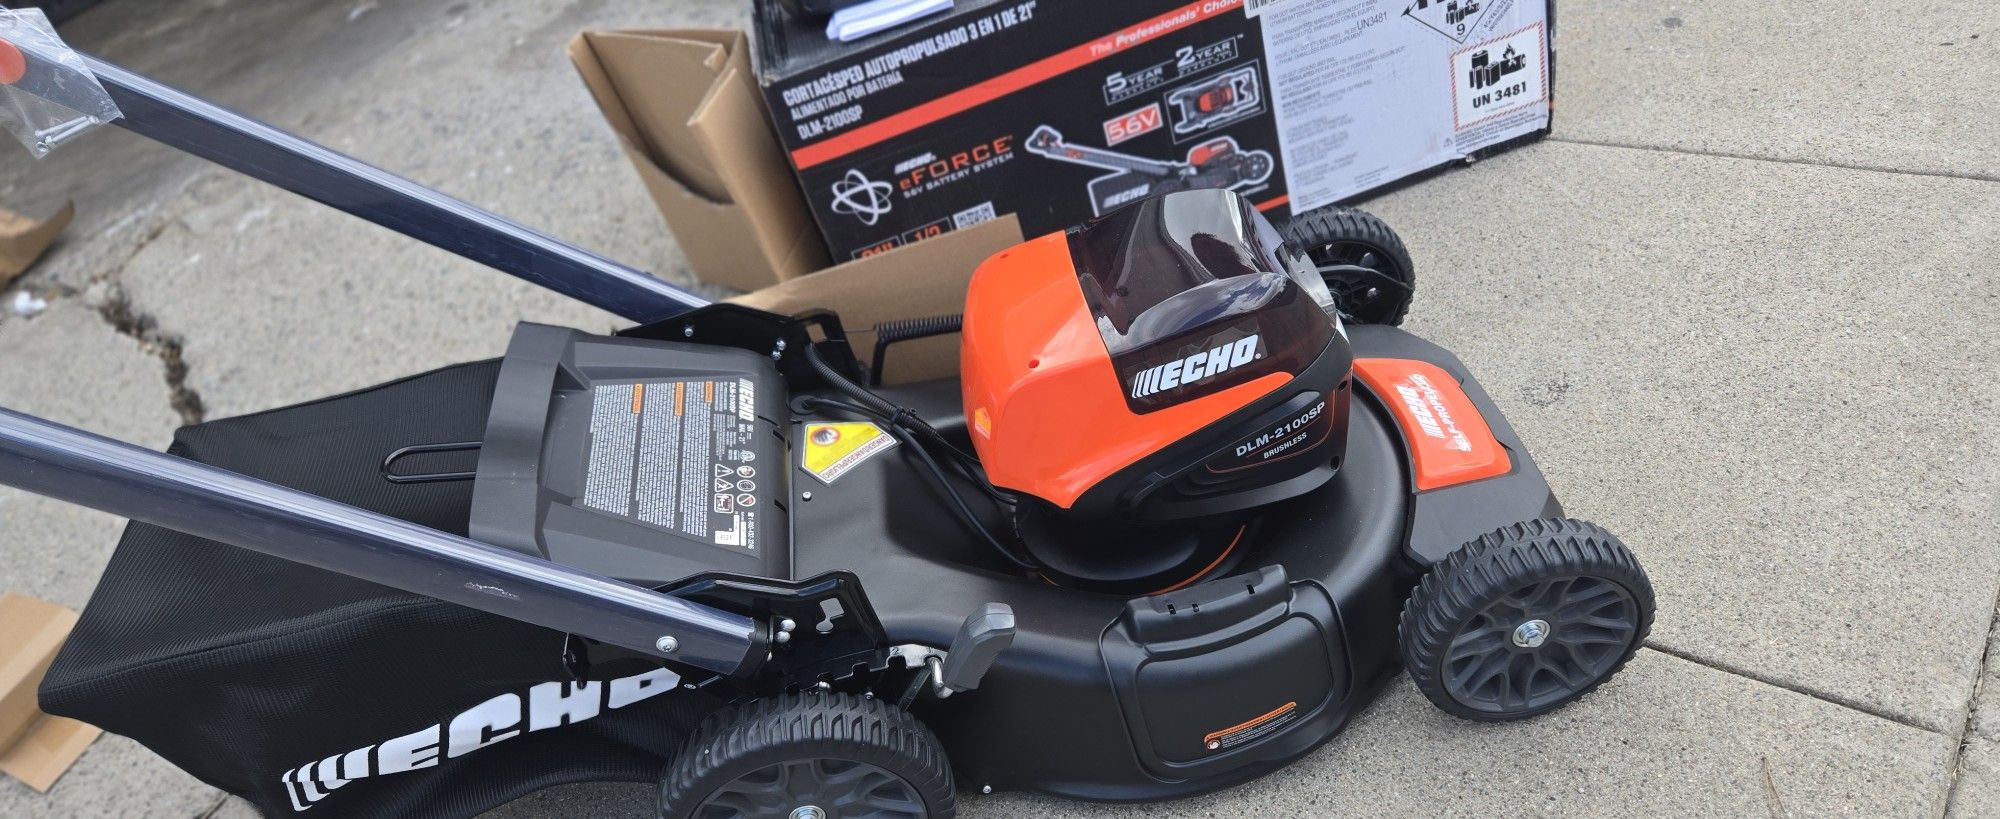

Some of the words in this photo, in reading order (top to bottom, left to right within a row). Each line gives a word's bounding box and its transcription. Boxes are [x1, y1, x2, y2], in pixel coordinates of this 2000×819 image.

[1090, 43, 1113, 57] The
[1116, 8, 1200, 45] Professionals'
[1356, 10, 1388, 31] UN3481
[1456, 23, 1466, 36] 9
[782, 66, 865, 107] CORTACÉSPED
[864, 26, 969, 79] AUTOPROPULSADO
[967, 23, 979, 40] 3
[977, 18, 996, 38] EN
[993, 15, 1003, 31] 1
[1000, 9, 1020, 27] DE
[1106, 71, 1127, 94] 5
[1129, 66, 1163, 87] YEAR
[1175, 45, 1196, 68] 2
[1196, 41, 1231, 61] YEAR
[790, 91, 848, 121] ALIMENTADO
[846, 86, 867, 103] POR
[865, 71, 904, 98] BATERÍA
[1472, 93, 1491, 109] UN
[1494, 81, 1526, 102] 3481
[796, 104, 864, 140] DLM-2100SP
[1108, 108, 1157, 142] 56V
[894, 152, 934, 175] ECHO
[899, 136, 1012, 191] eFORCE
[903, 185, 924, 199] 56V
[926, 169, 971, 191] BATTERY
[973, 151, 1014, 174] SYSTEM
[1103, 184, 1150, 208] ECHO
[1131, 334, 1259, 399] ECHO
[738, 378, 755, 422] ECHO
[1396, 385, 1446, 438] ECHO
[1235, 401, 1326, 457] DLM-2100SP
[1263, 431, 1308, 459] BRUSHLESS
[281, 666, 682, 812] ECHO
